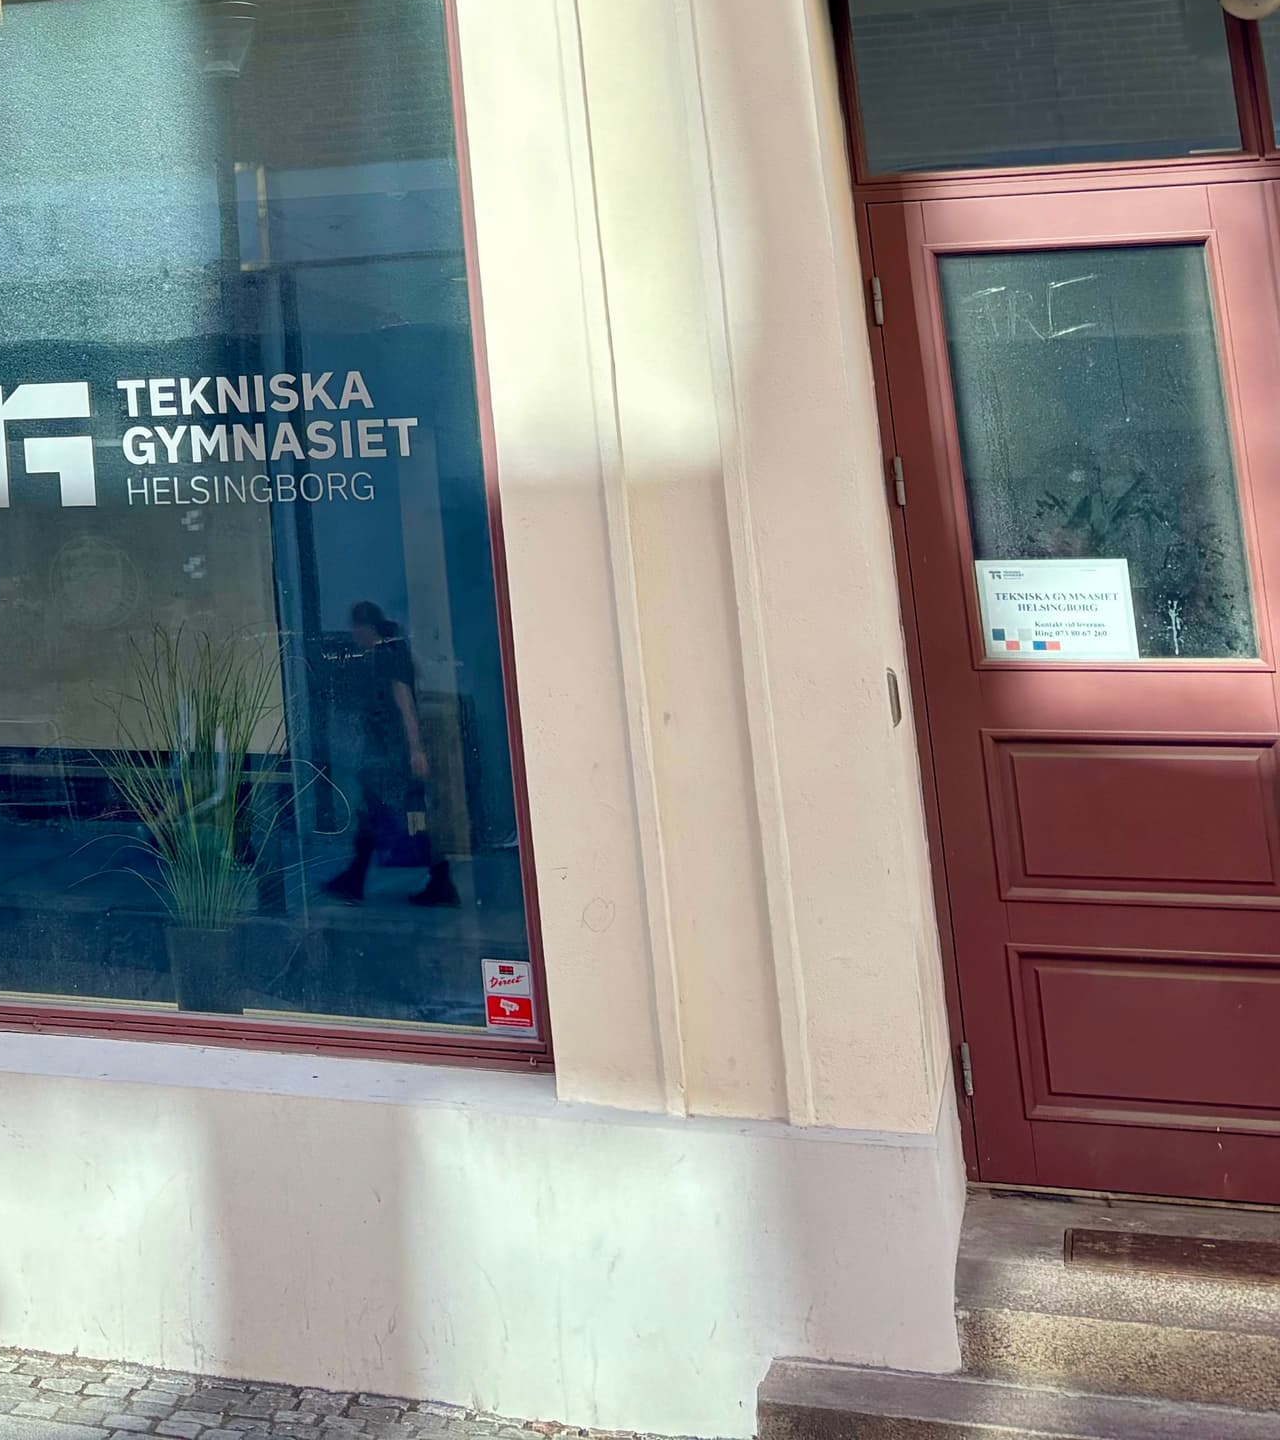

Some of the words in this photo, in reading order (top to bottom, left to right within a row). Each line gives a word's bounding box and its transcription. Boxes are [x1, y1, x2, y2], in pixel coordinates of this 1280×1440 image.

[116, 370, 375, 418] TEKNISKA
[121, 417, 419, 466] GYMNASIET
[127, 471, 375, 506] HELSINGBORG
[995, 592, 1050, 601] TEKNISKA
[1052, 592, 1119, 601] GYMNASIET
[1017, 603, 1099, 612] HELSINGBORG
